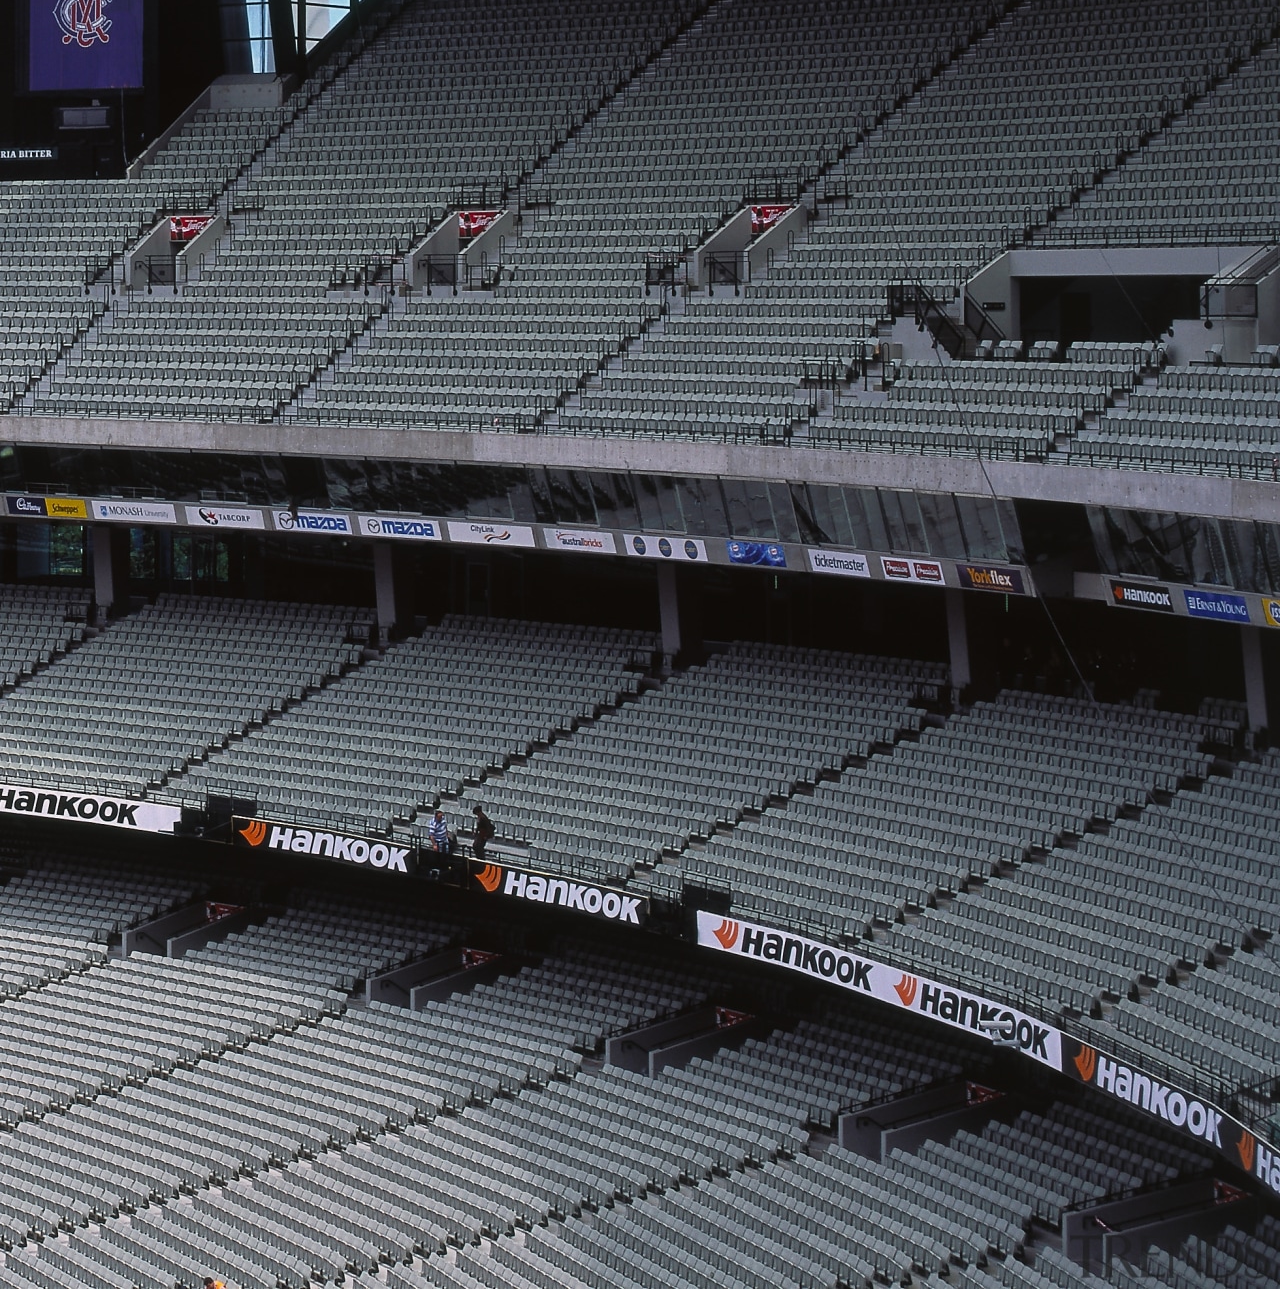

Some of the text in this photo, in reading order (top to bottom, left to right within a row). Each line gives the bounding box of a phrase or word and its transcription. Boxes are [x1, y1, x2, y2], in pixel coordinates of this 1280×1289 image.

[18, 150, 52, 158] BITTER
[109, 506, 169, 519] MONASH University
[218, 513, 251, 522] TABCORP
[470, 524, 495, 534] CityLink
[814, 554, 865, 572] ticketmaster
[966, 567, 1013, 586] Yorkflex
